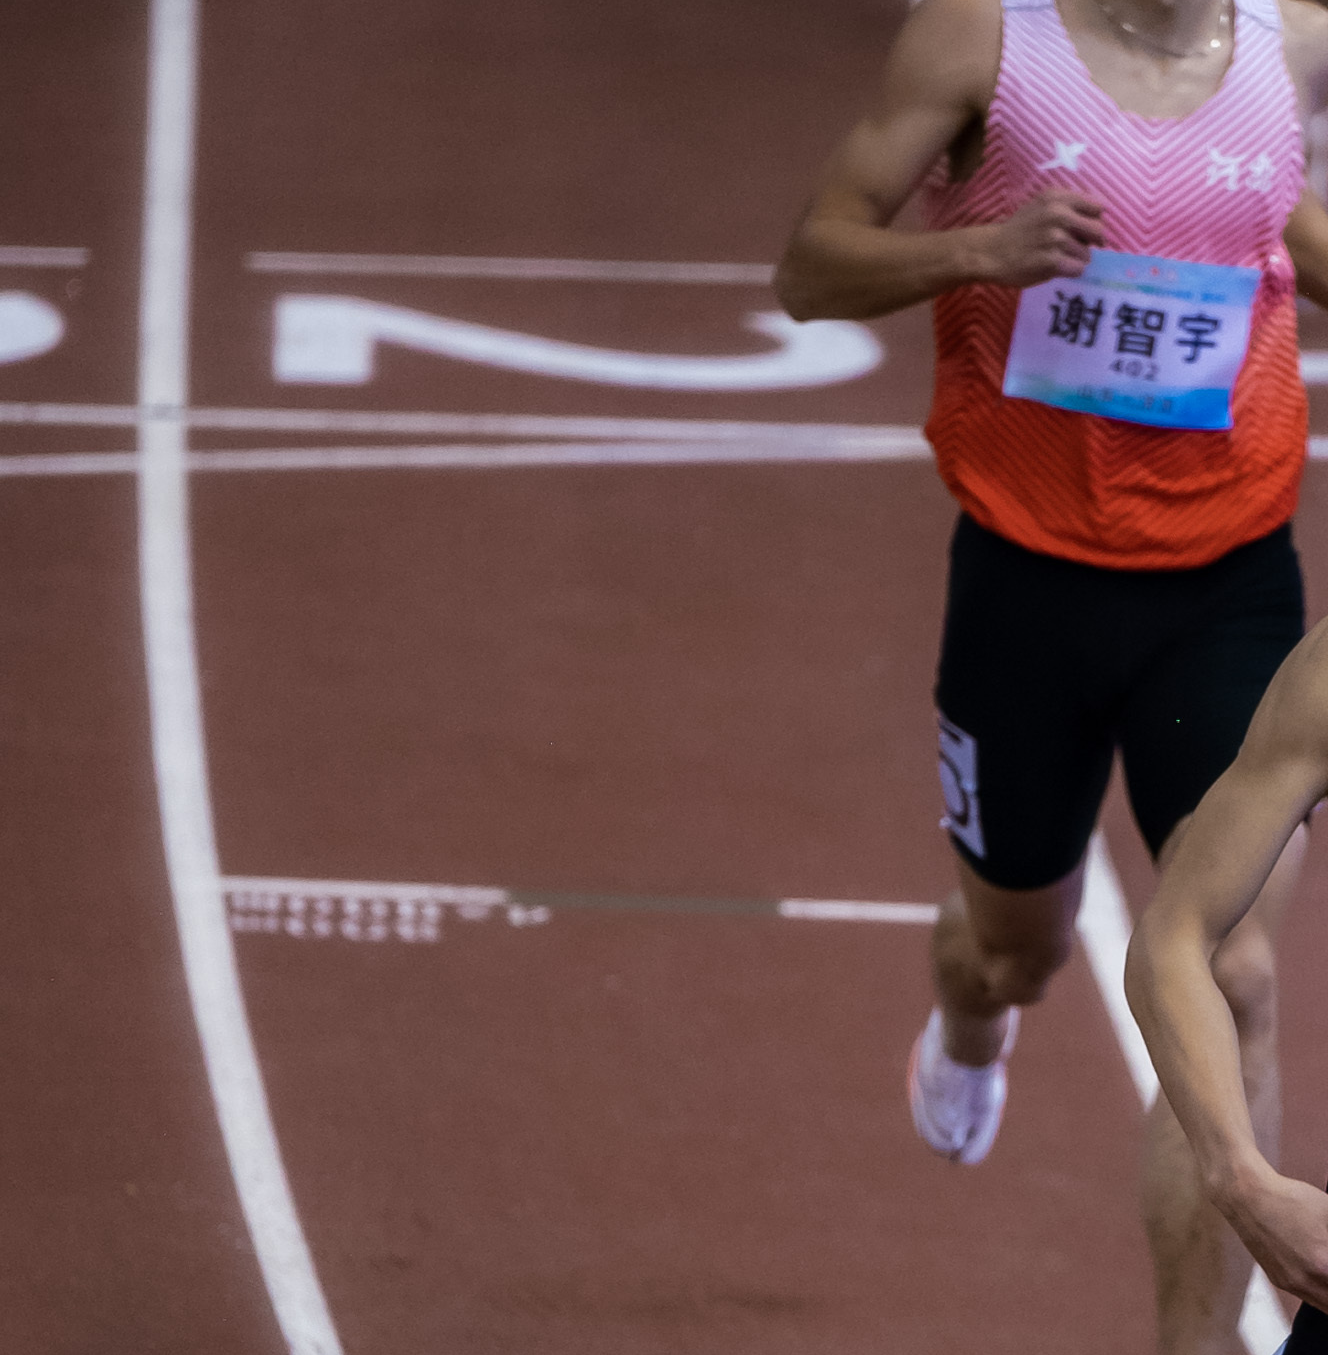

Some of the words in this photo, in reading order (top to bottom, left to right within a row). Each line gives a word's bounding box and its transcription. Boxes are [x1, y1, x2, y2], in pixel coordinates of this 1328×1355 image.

[271, 292, 883, 392] 2
[1048, 290, 1222, 364] 谢智宇
